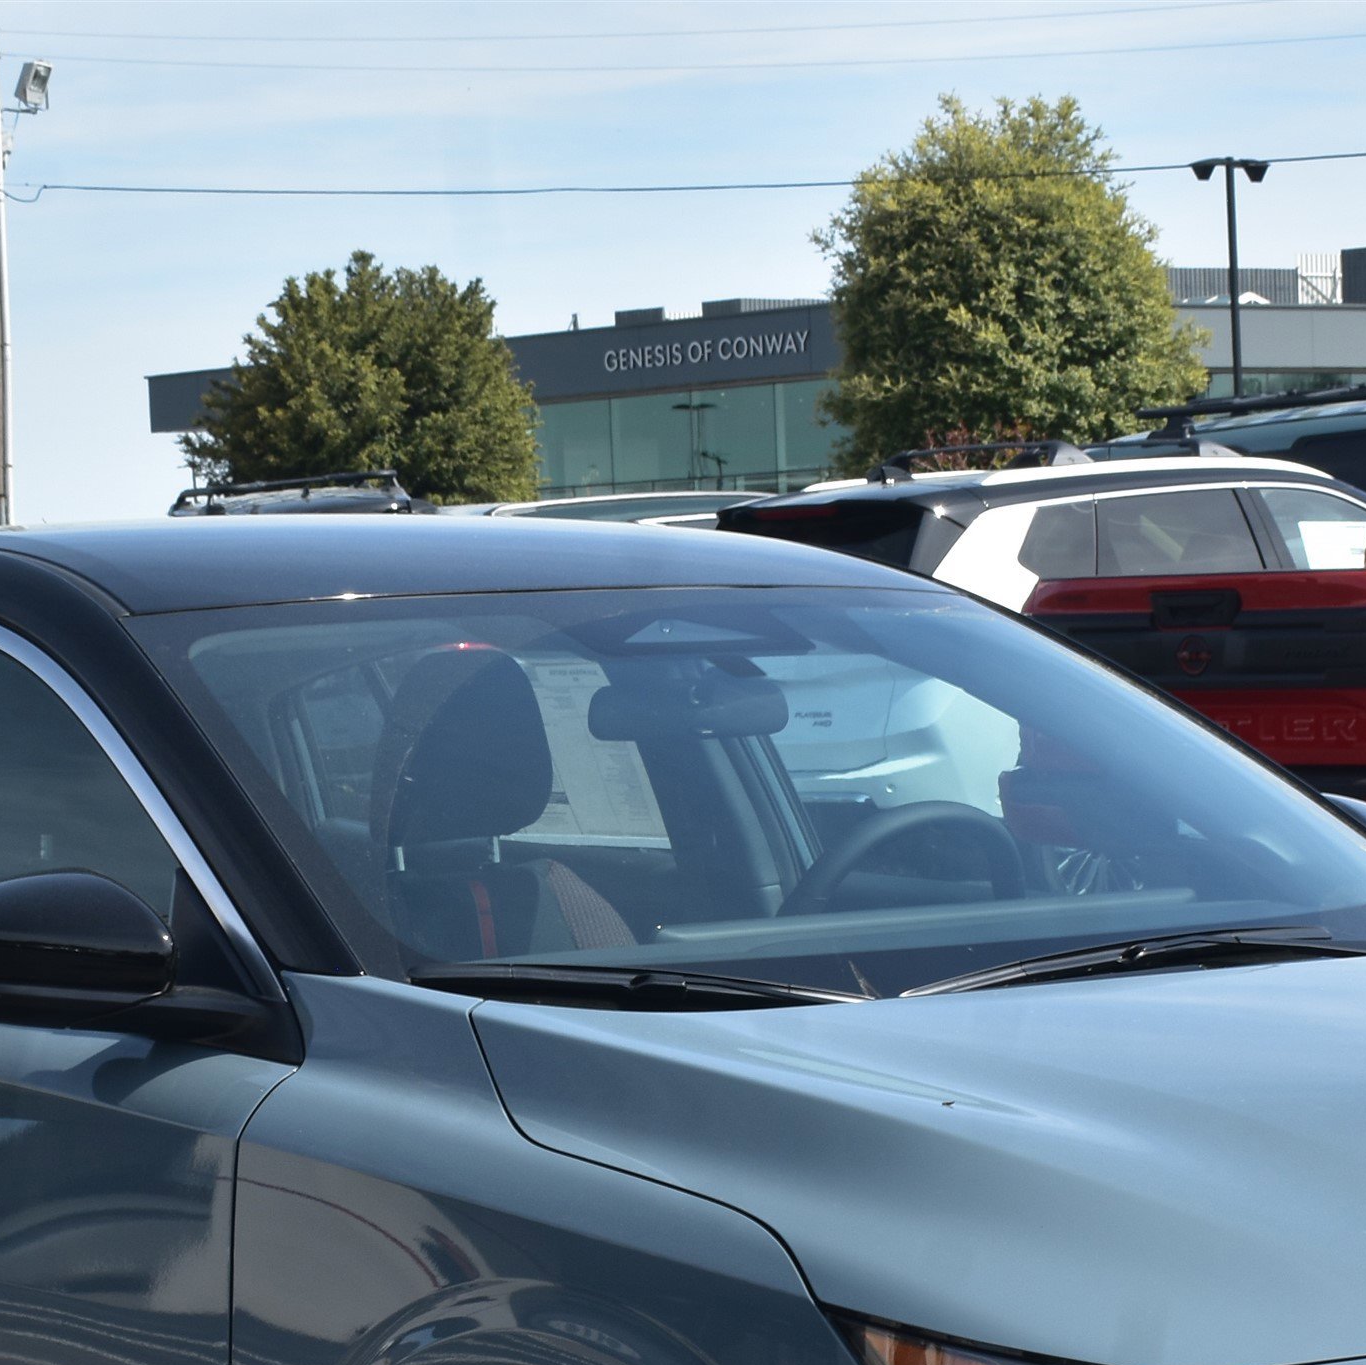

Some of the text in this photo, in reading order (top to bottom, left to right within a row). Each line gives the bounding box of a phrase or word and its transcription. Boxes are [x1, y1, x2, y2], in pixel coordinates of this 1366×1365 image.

[604, 330, 809, 372] GENESIS OF CONWAY
